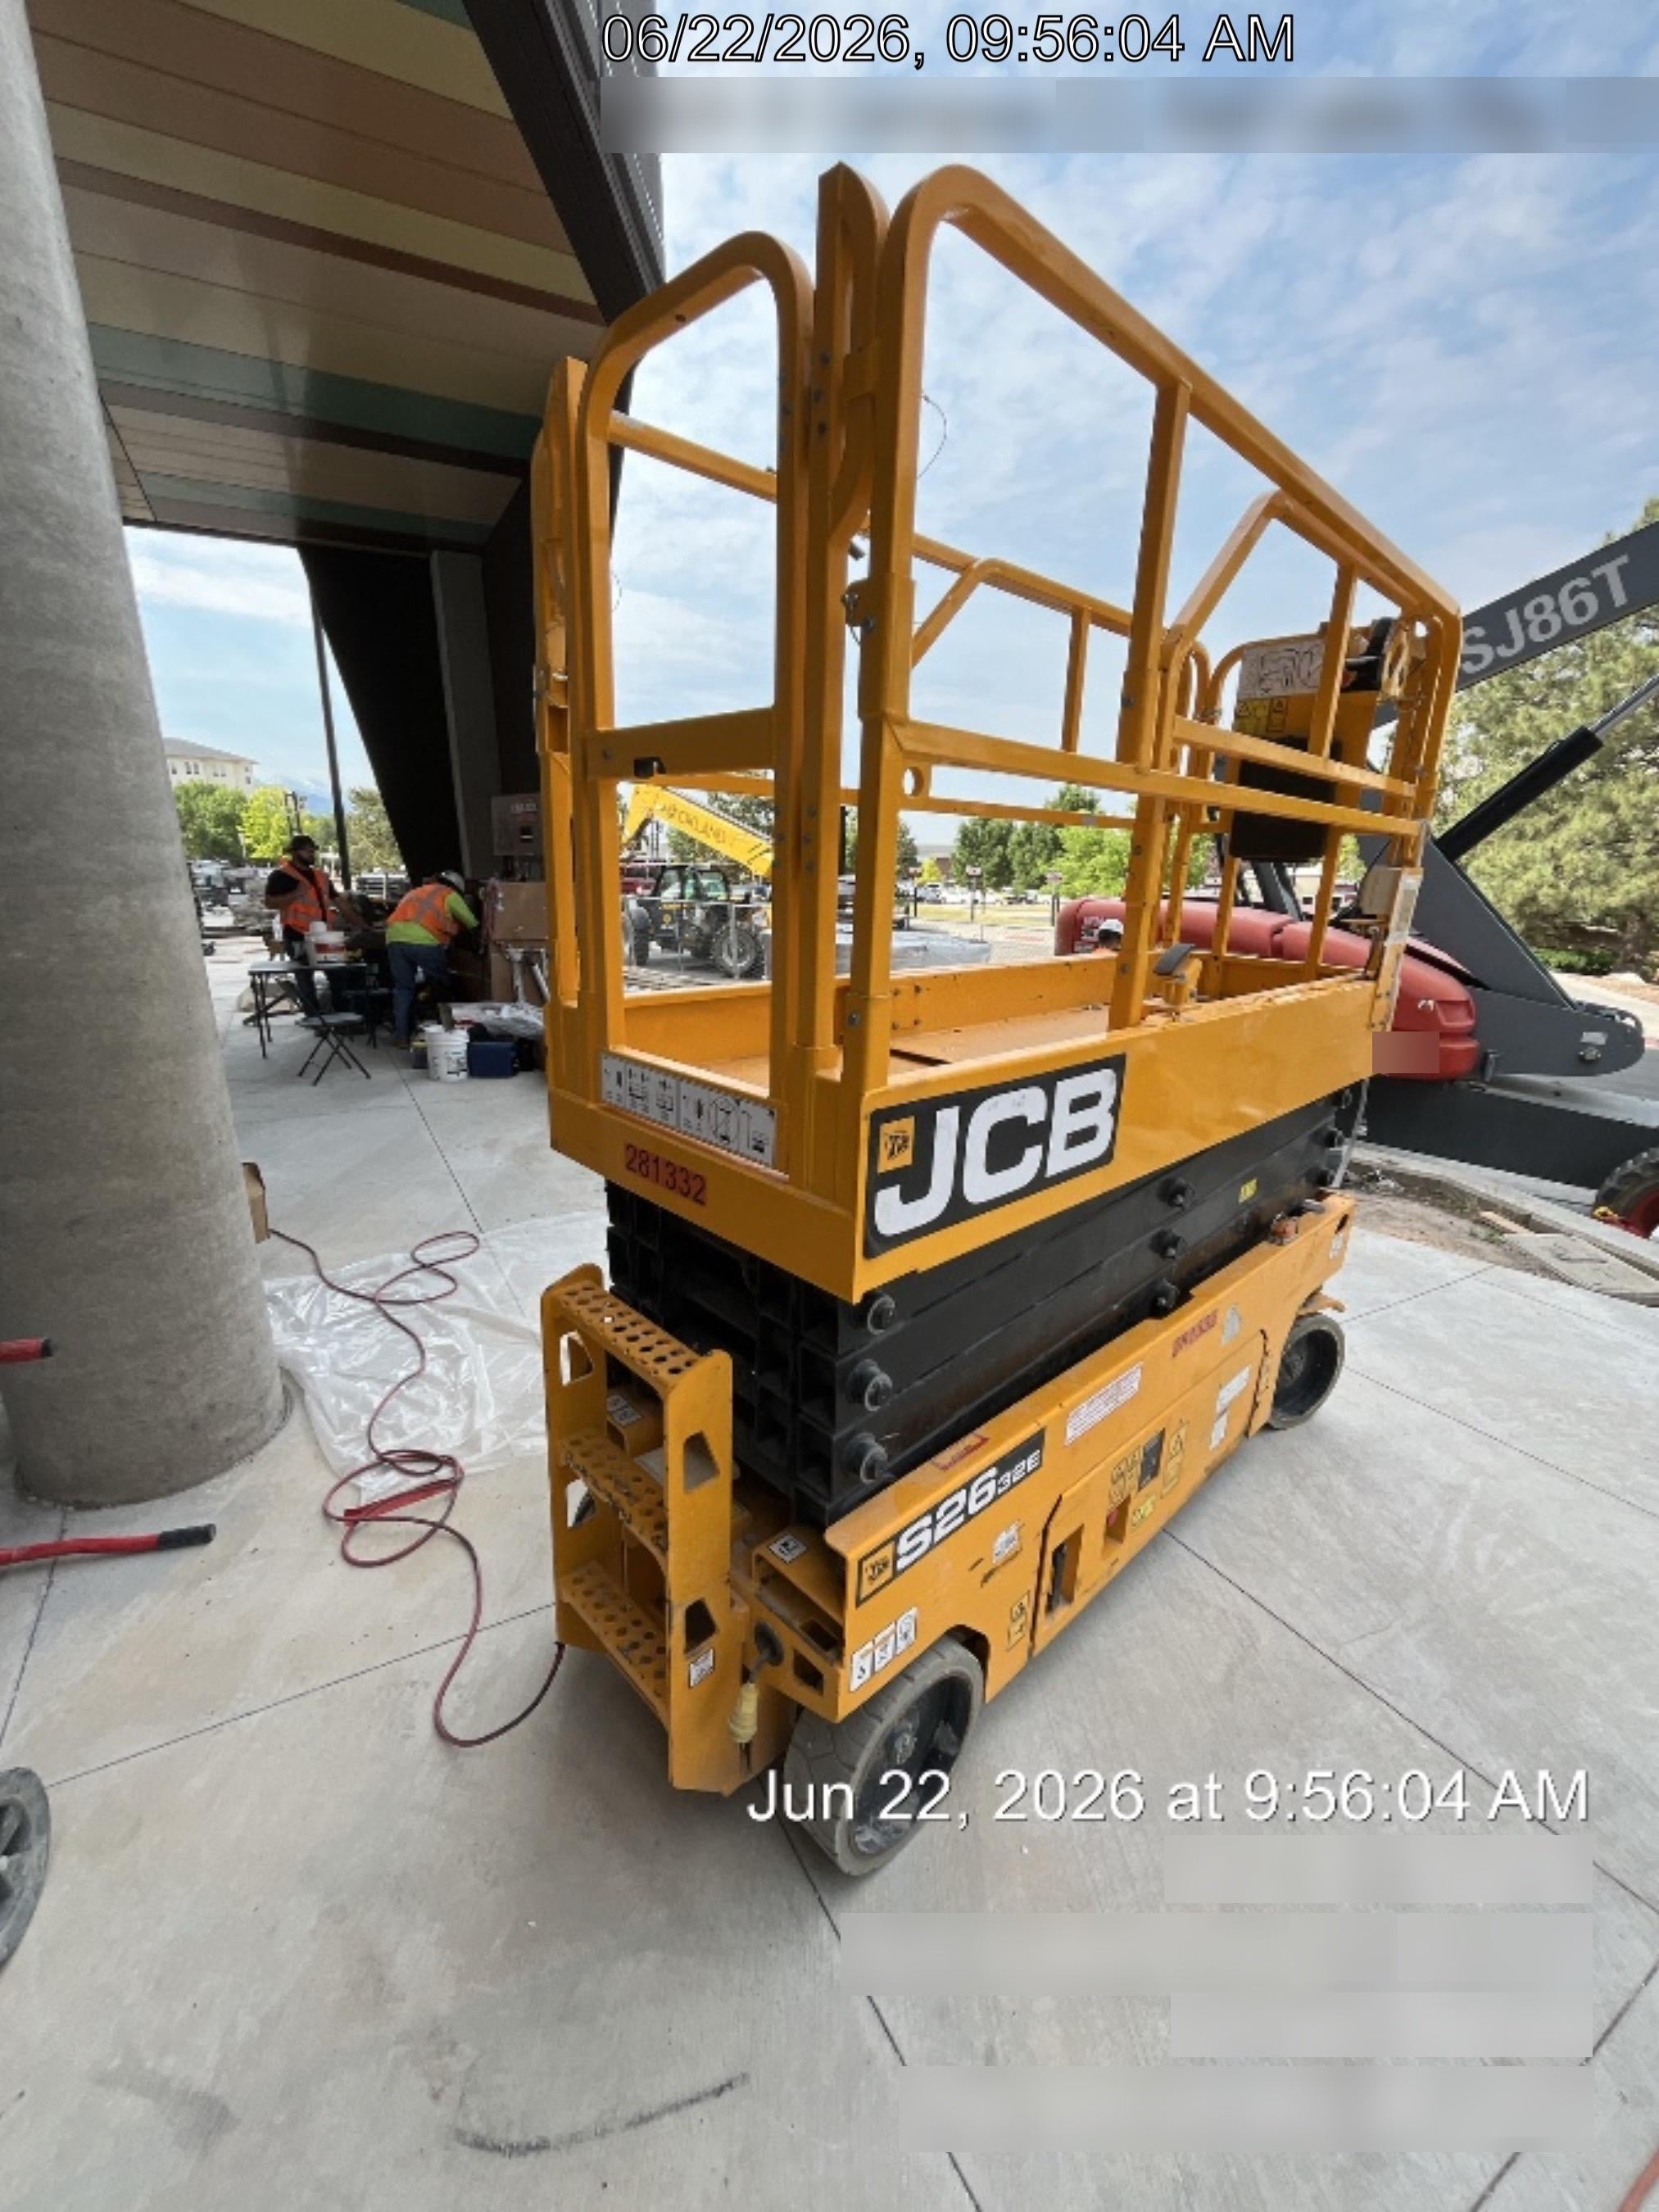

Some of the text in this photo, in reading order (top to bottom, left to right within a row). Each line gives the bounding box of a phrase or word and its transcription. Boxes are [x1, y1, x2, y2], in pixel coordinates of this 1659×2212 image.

[1462, 553, 1630, 674] SJ86T
[624, 1145, 707, 1206] 281332
[874, 1068, 1117, 1237] JCB
